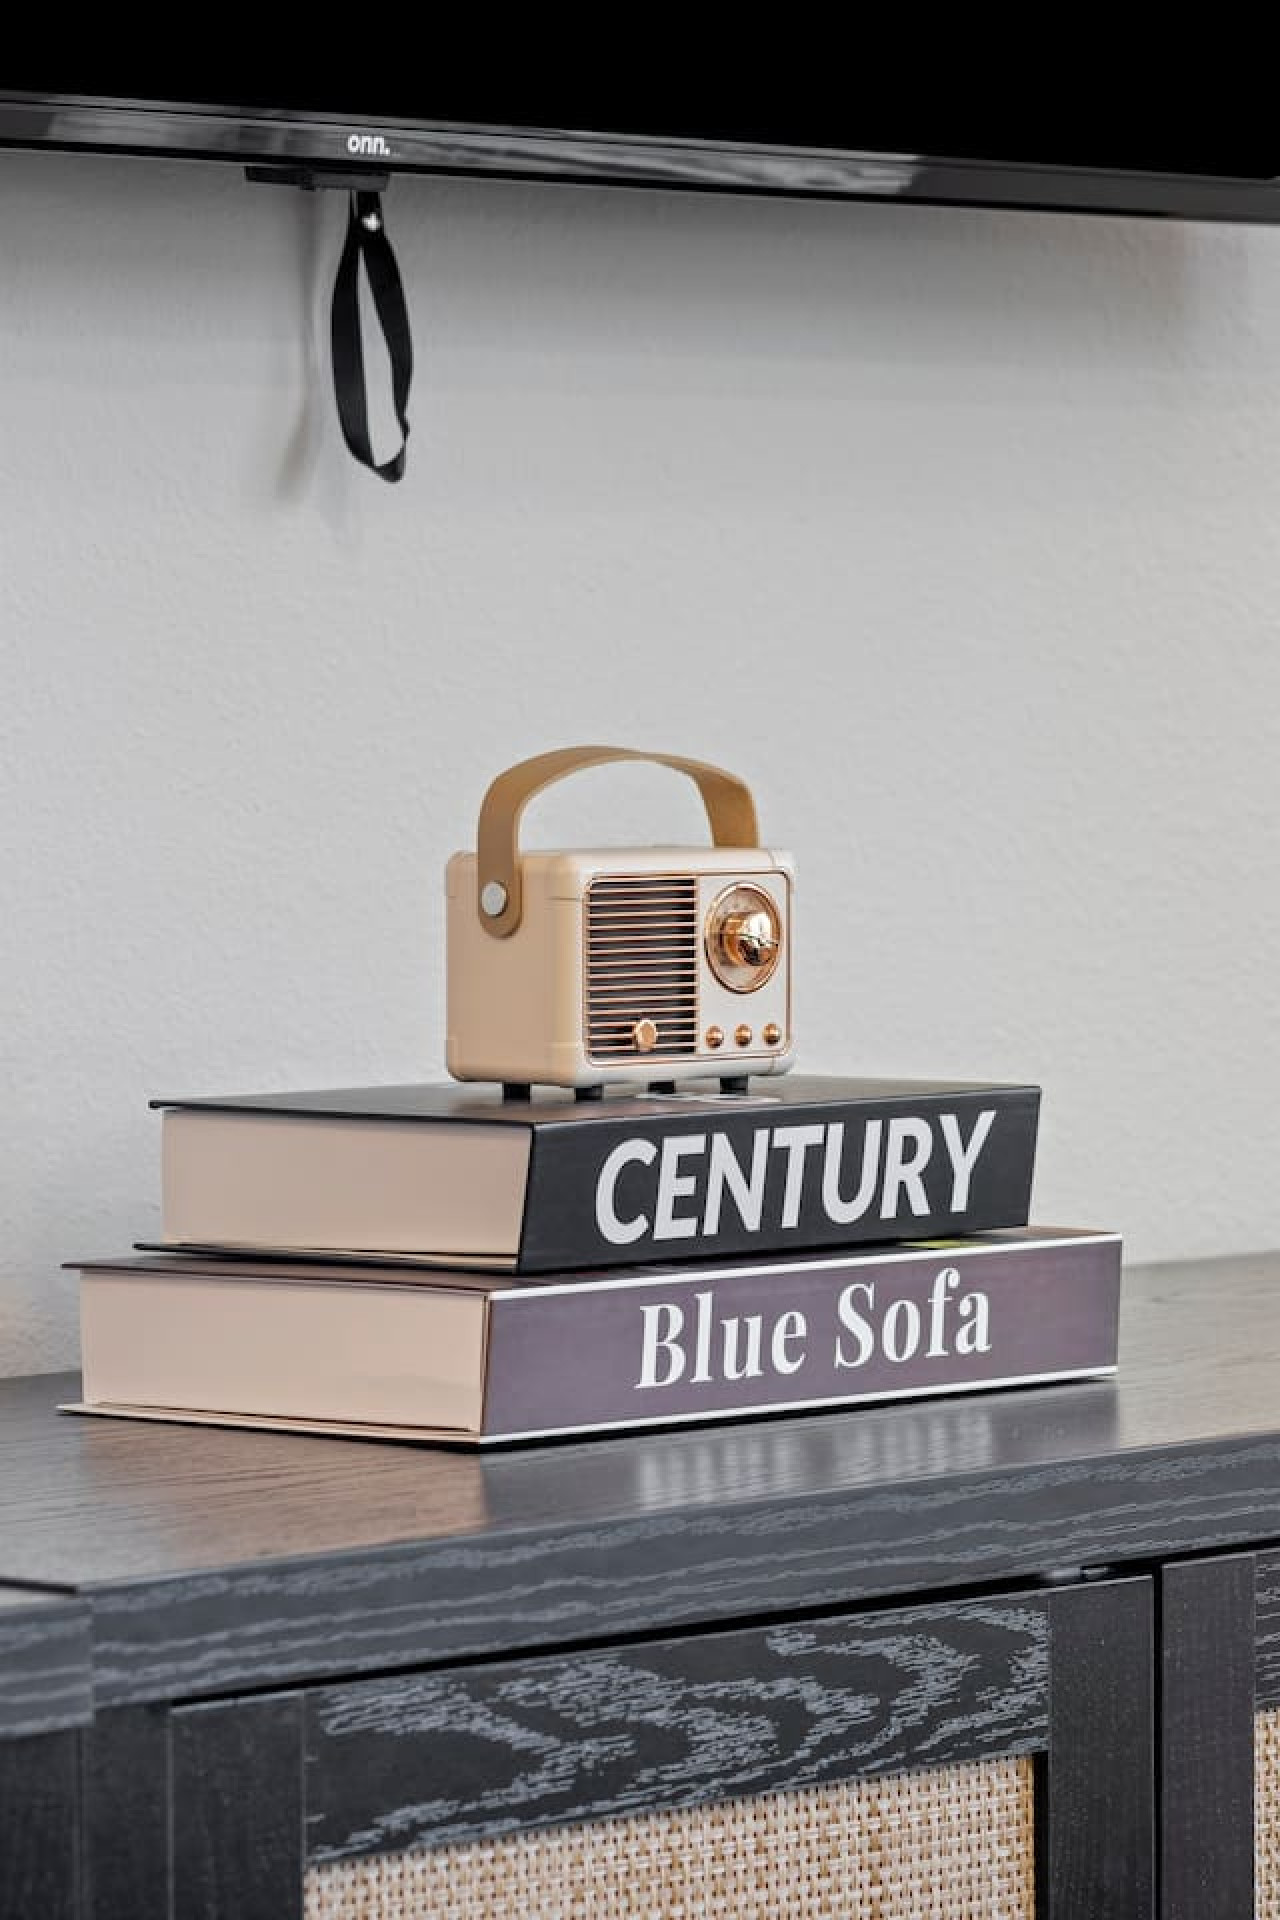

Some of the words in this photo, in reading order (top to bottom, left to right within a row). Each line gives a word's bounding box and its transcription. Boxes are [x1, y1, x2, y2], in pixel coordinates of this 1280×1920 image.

[595, 1109, 997, 1246] CENTURY
[635, 1291, 807, 1389] Blue
[833, 1267, 992, 1370] Sofa
